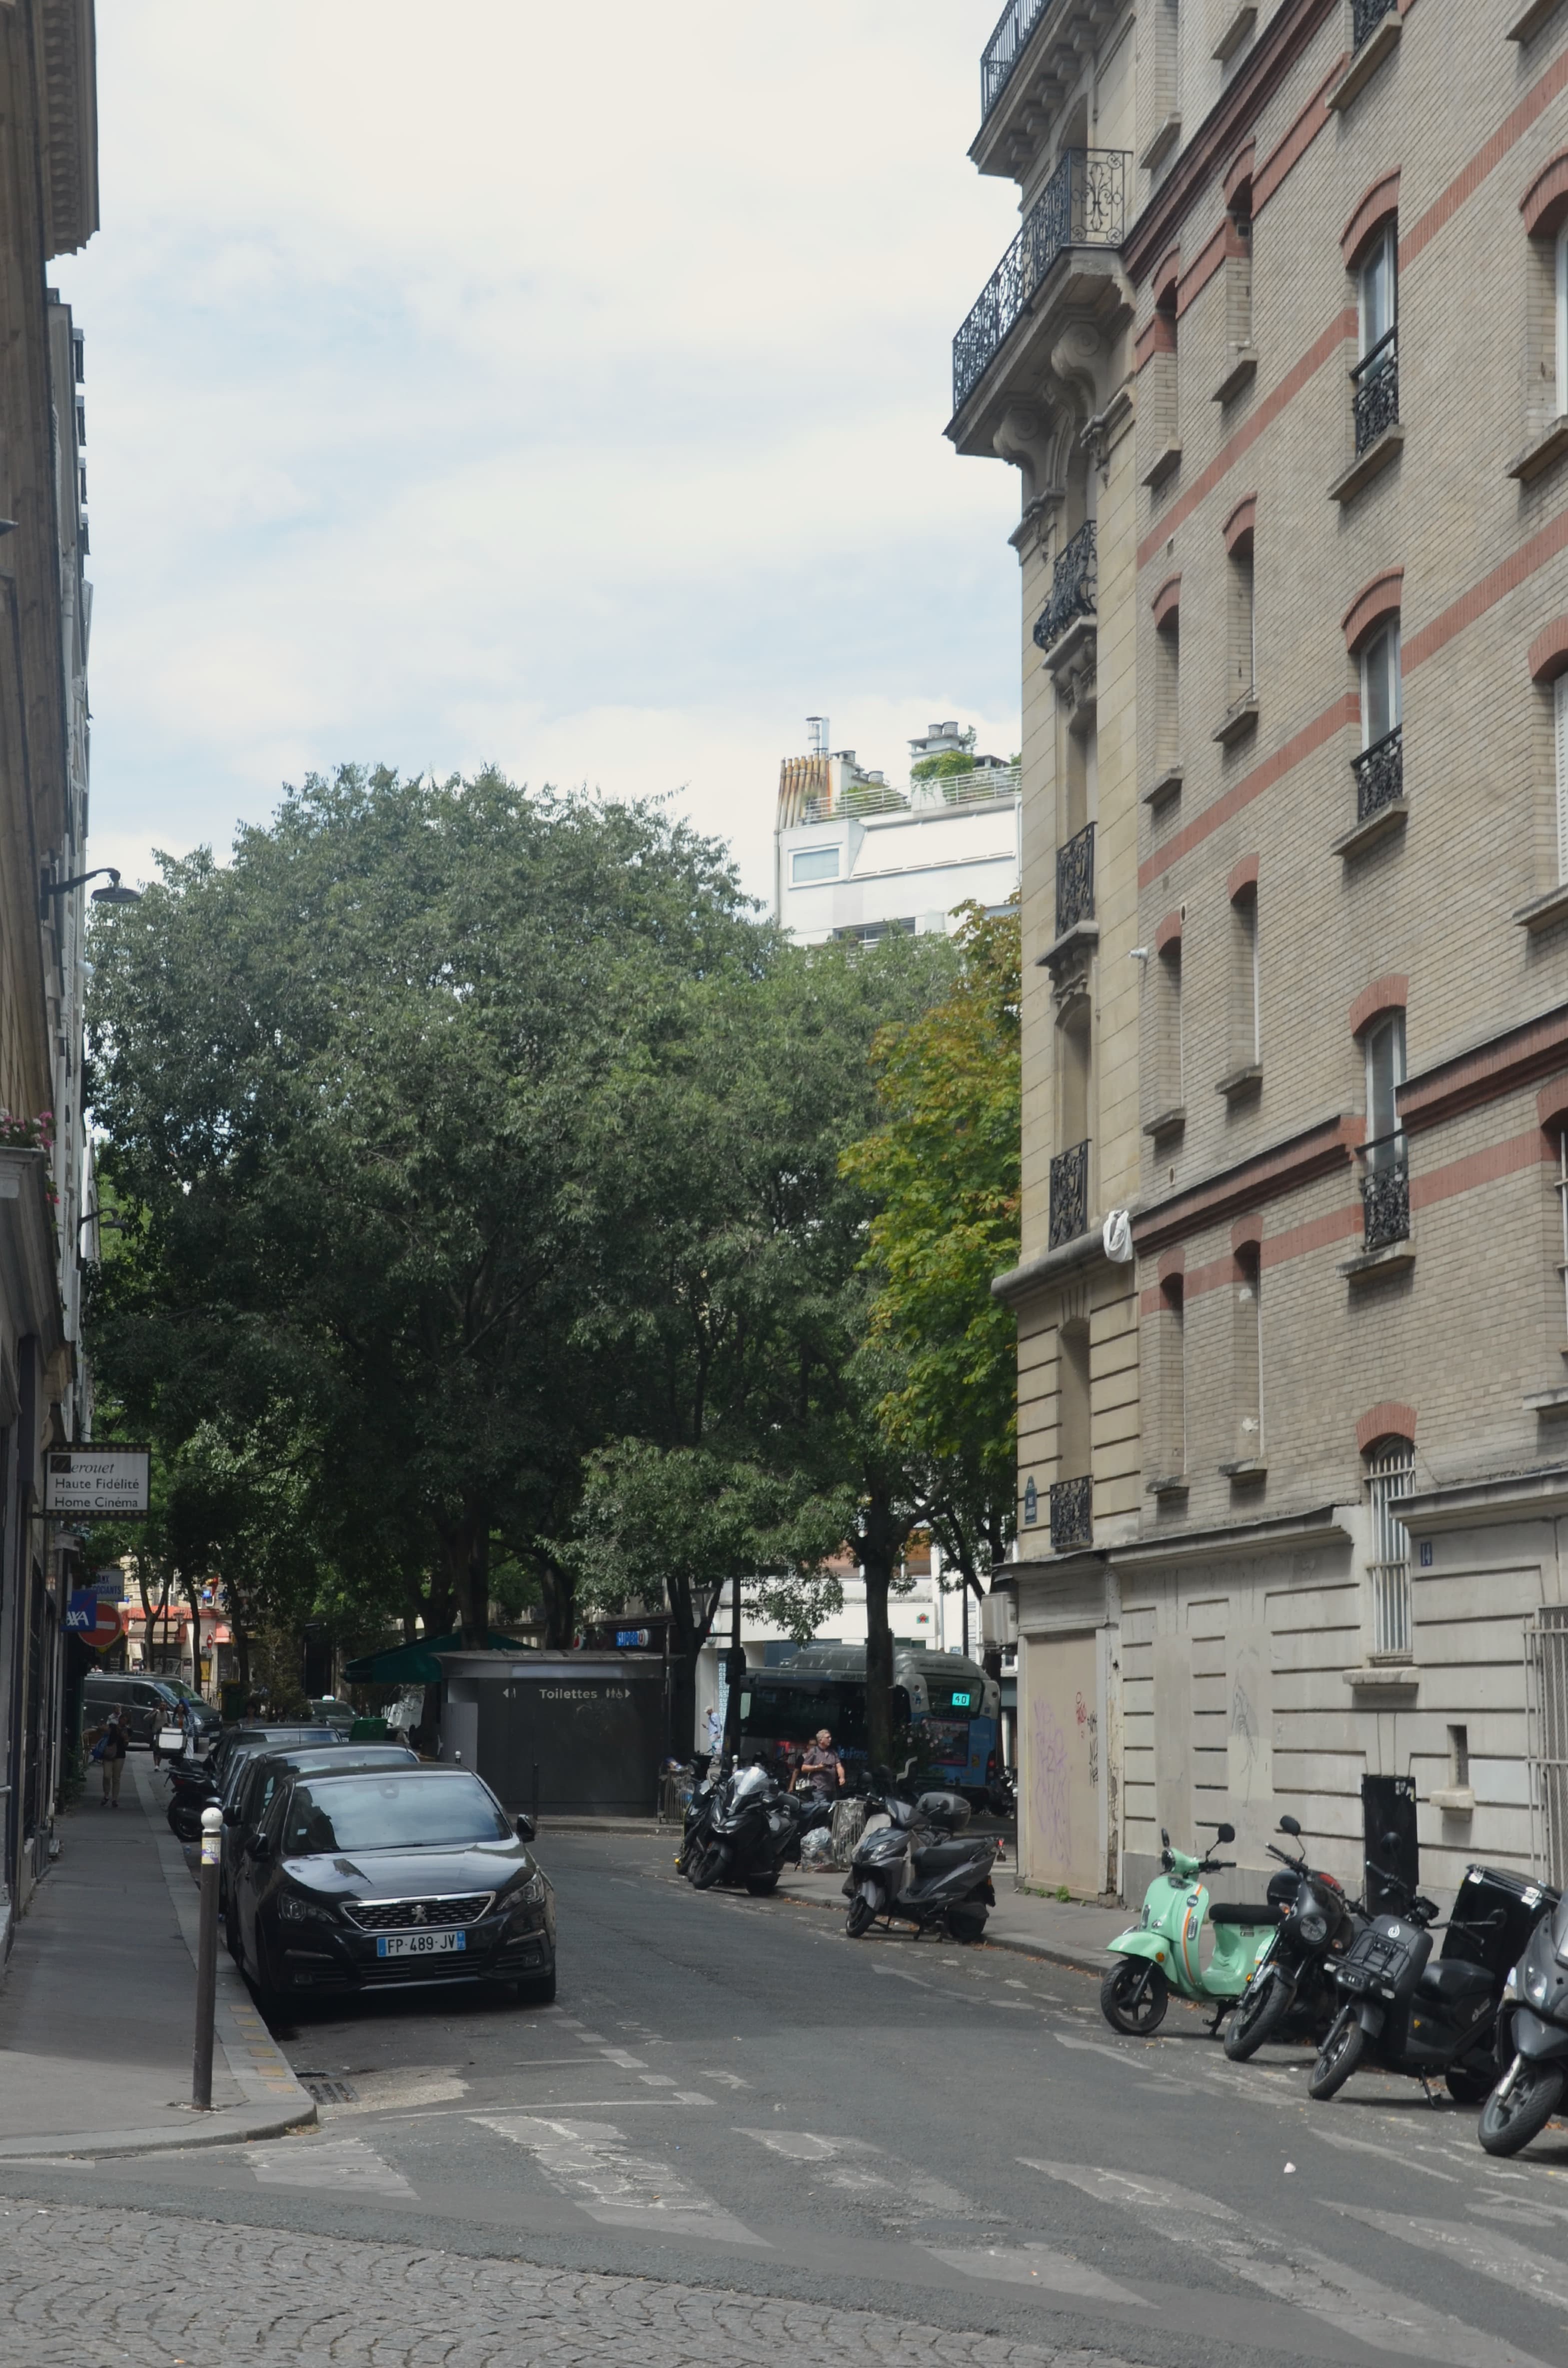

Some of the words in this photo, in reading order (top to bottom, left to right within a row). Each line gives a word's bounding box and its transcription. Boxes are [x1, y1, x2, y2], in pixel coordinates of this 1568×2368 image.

[55, 1478, 91, 1489] Haute
[96, 1478, 139, 1490] Fidélité
[54, 1496, 90, 1508] Home
[94, 1496, 138, 1508] Cinéma
[1422, 1544, 1431, 1565] 14
[66, 1612, 89, 1626] AXA
[539, 1688, 598, 1699] Toilettes
[955, 1695, 967, 1704] 40
